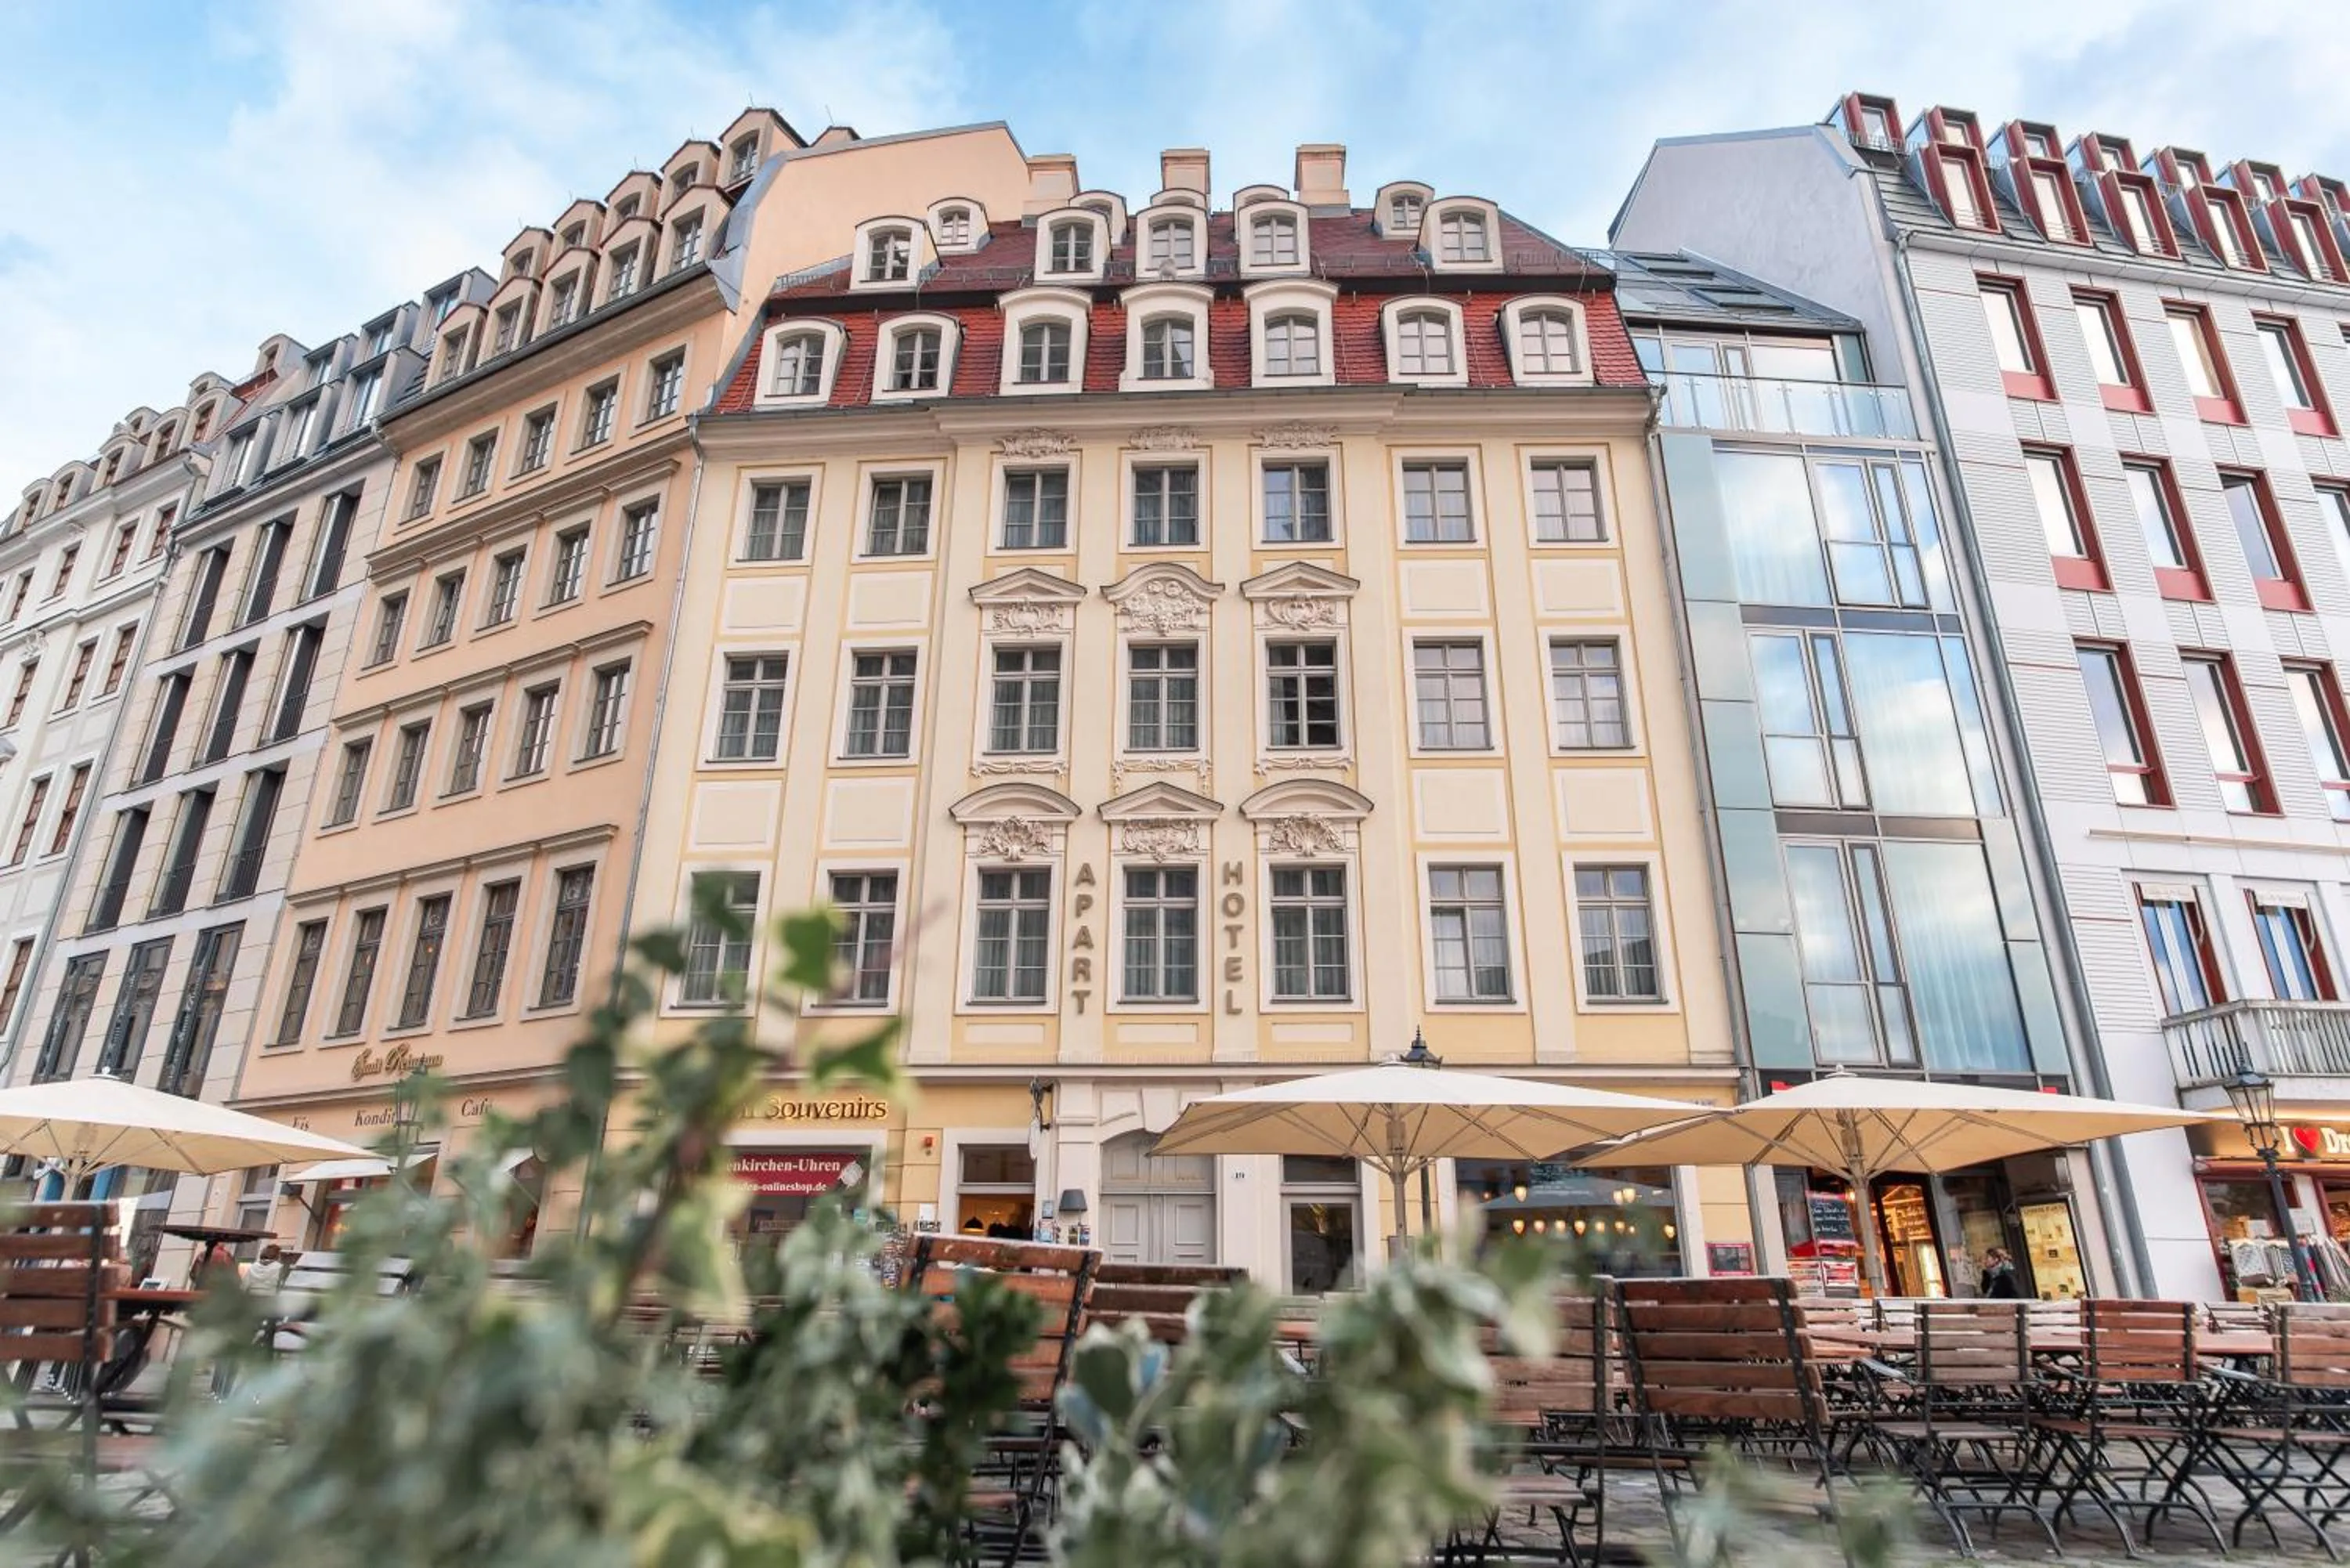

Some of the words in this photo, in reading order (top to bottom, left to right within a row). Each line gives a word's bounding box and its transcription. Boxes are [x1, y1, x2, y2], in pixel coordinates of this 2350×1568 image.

[1071, 862, 1097, 1015] APART
[1221, 860, 1246, 1016] HOTEL
[765, 1093, 888, 1120] Souvenirs
[2319, 1127, 2350, 1154] Dr
[725, 1158, 841, 1172] enkirchen-Uhren
